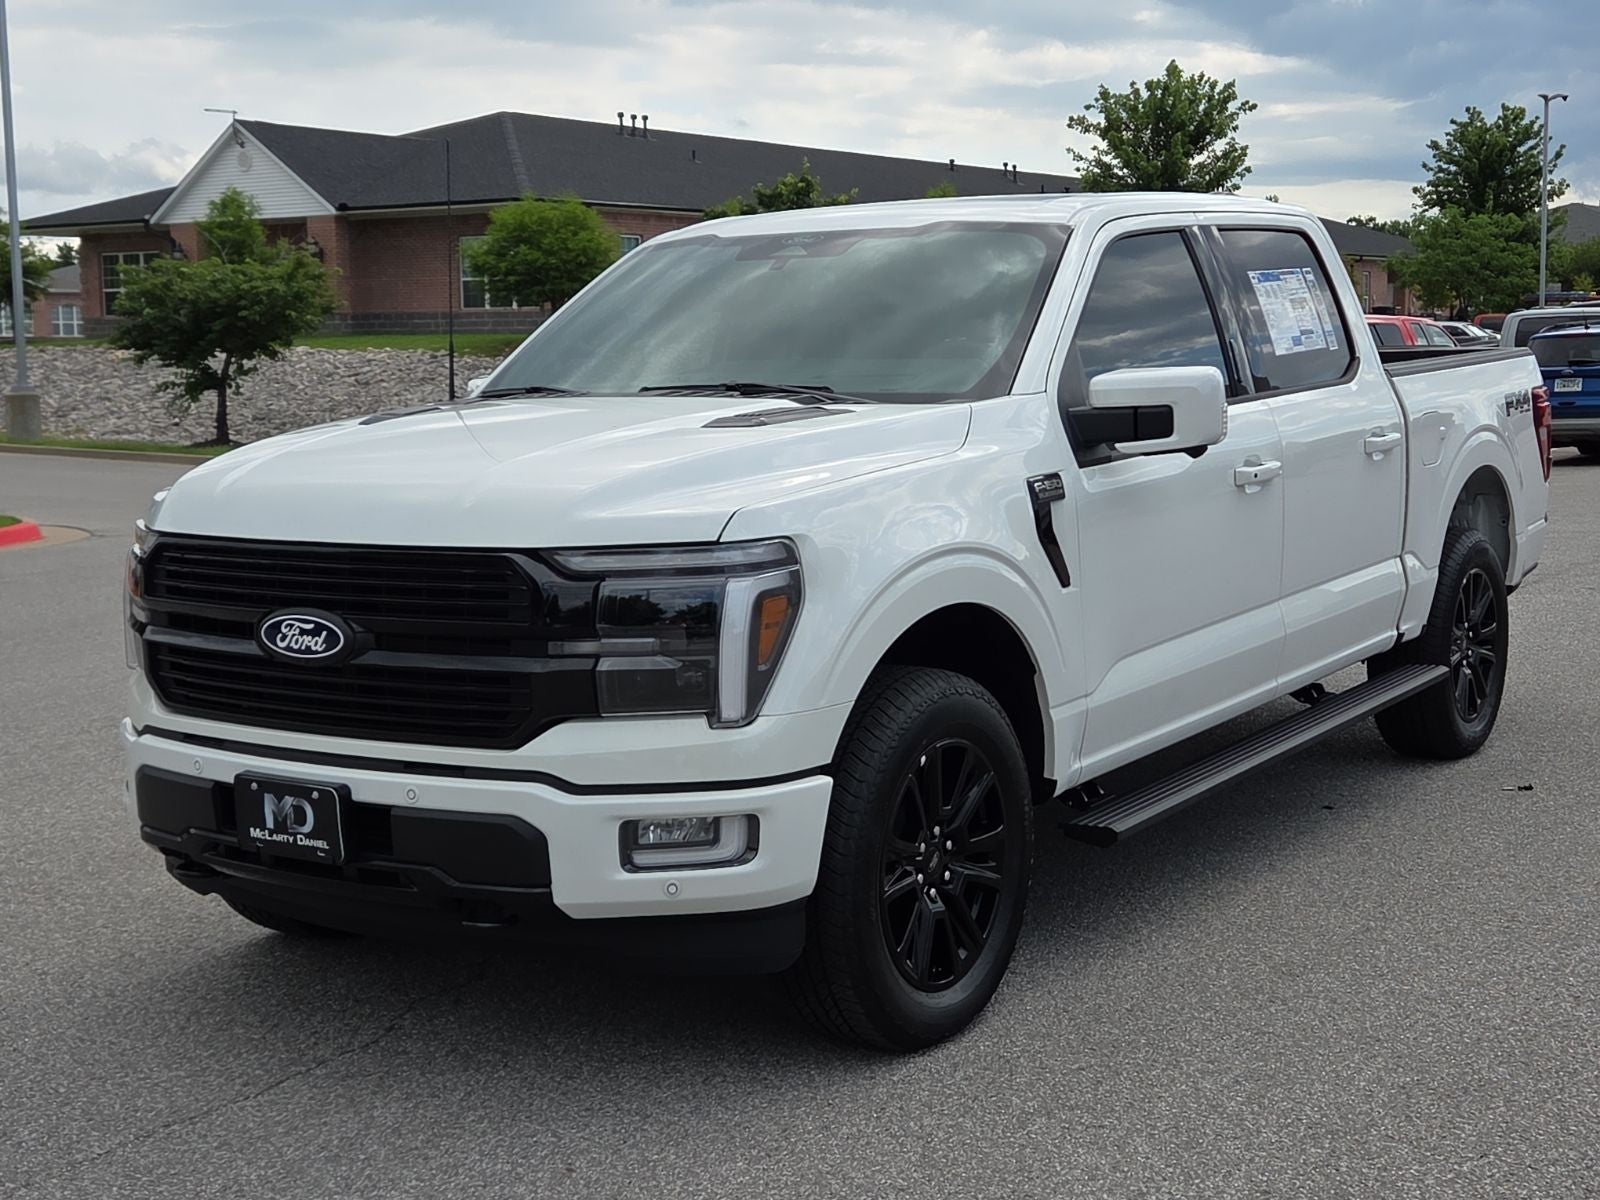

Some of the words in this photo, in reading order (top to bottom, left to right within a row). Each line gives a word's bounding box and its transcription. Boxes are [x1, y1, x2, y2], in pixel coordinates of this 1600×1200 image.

[276, 620, 328, 652] Ford
[263, 792, 315, 834] MD
[296, 834, 330, 850] DANIEL
